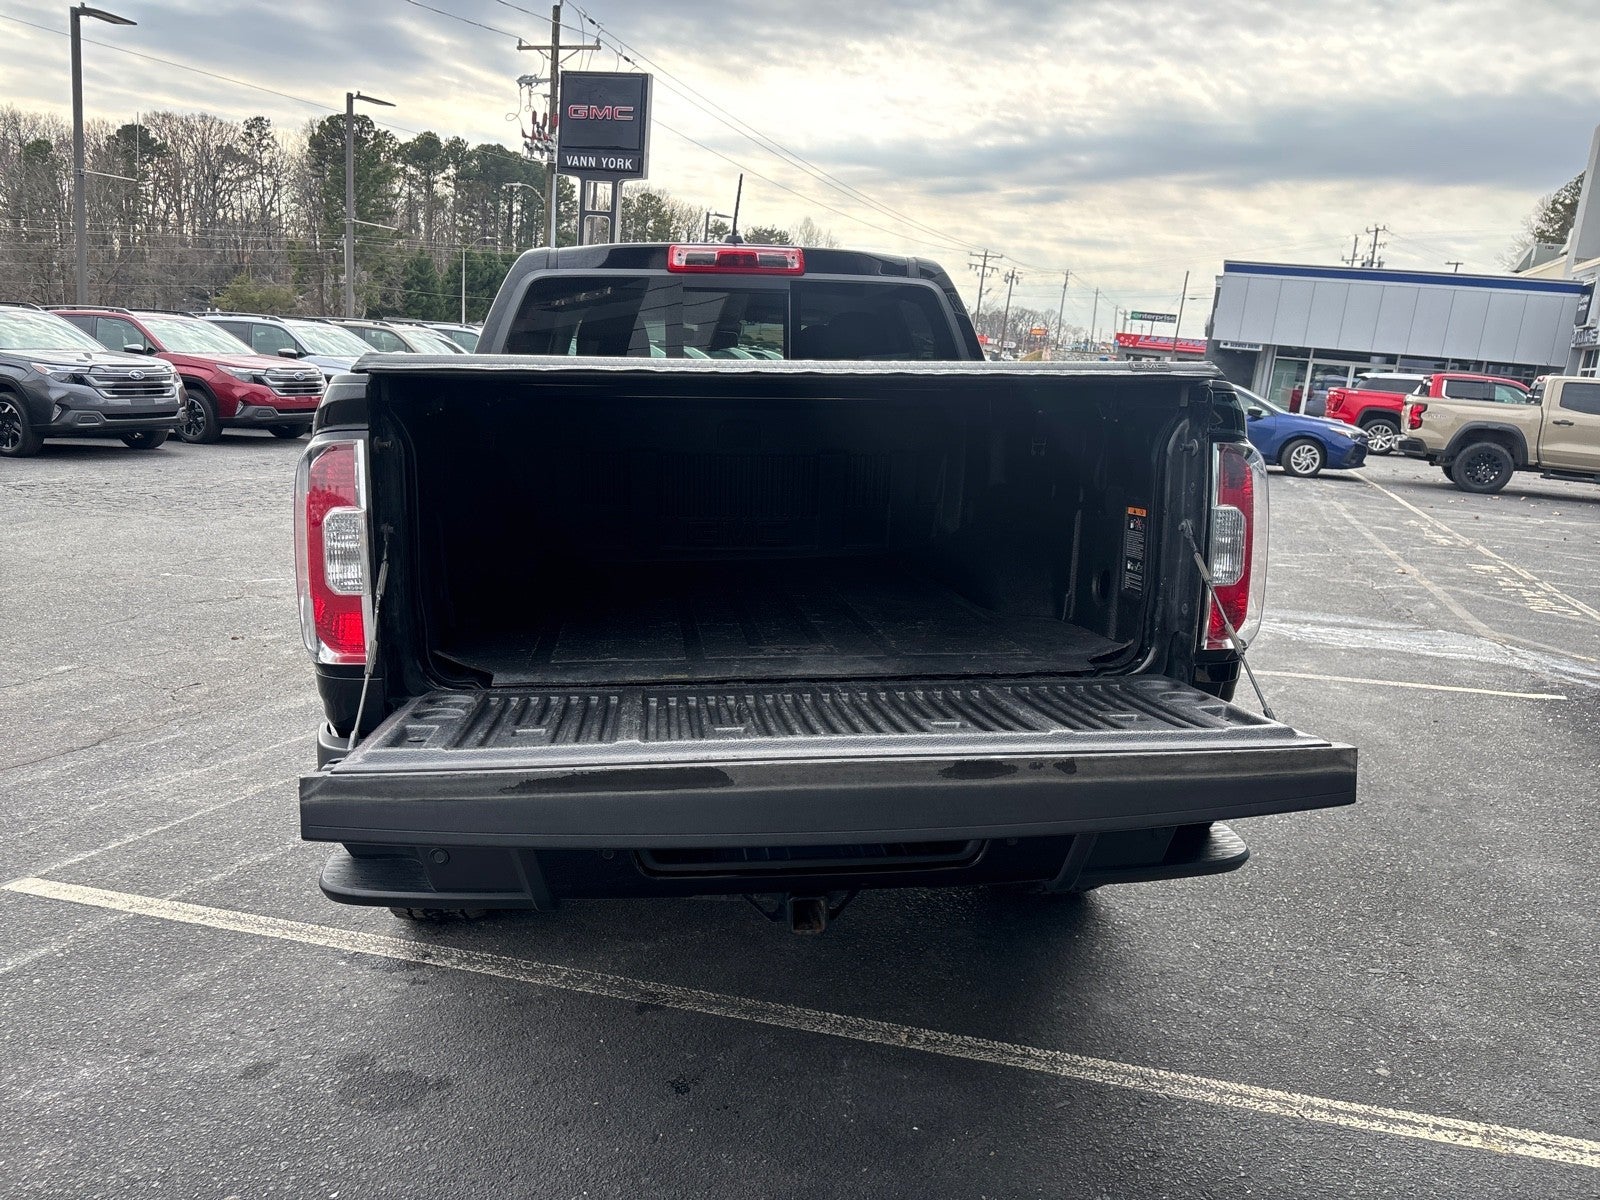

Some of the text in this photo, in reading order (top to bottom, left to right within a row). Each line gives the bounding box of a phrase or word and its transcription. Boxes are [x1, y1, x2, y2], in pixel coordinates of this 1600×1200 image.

[568, 104, 634, 121] GMC
[566, 155, 633, 170] VANN YORK
[1133, 312, 1176, 322] enterprise
